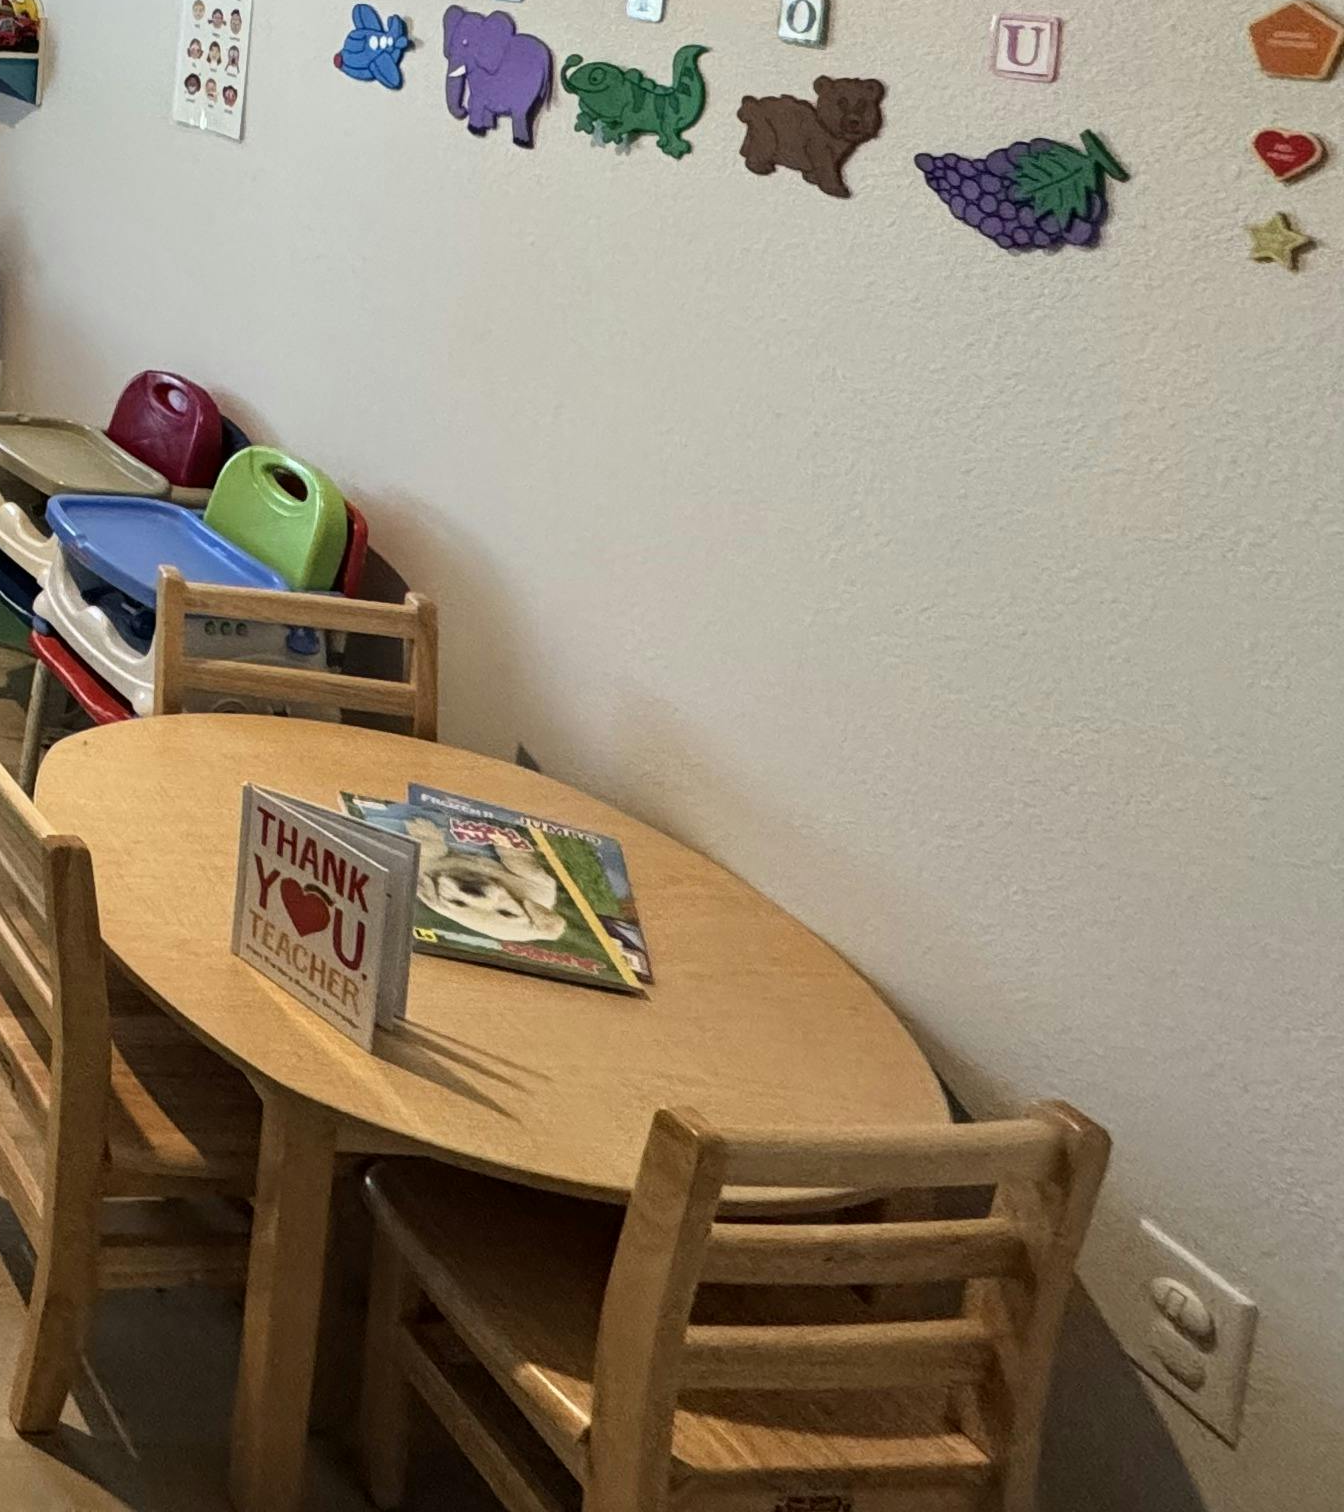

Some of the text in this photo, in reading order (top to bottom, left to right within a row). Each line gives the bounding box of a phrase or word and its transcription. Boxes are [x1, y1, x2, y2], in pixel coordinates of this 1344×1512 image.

[1003, 24, 1045, 66] U
[257, 805, 369, 913] THANK
[249, 908, 361, 1018] TEACHER
